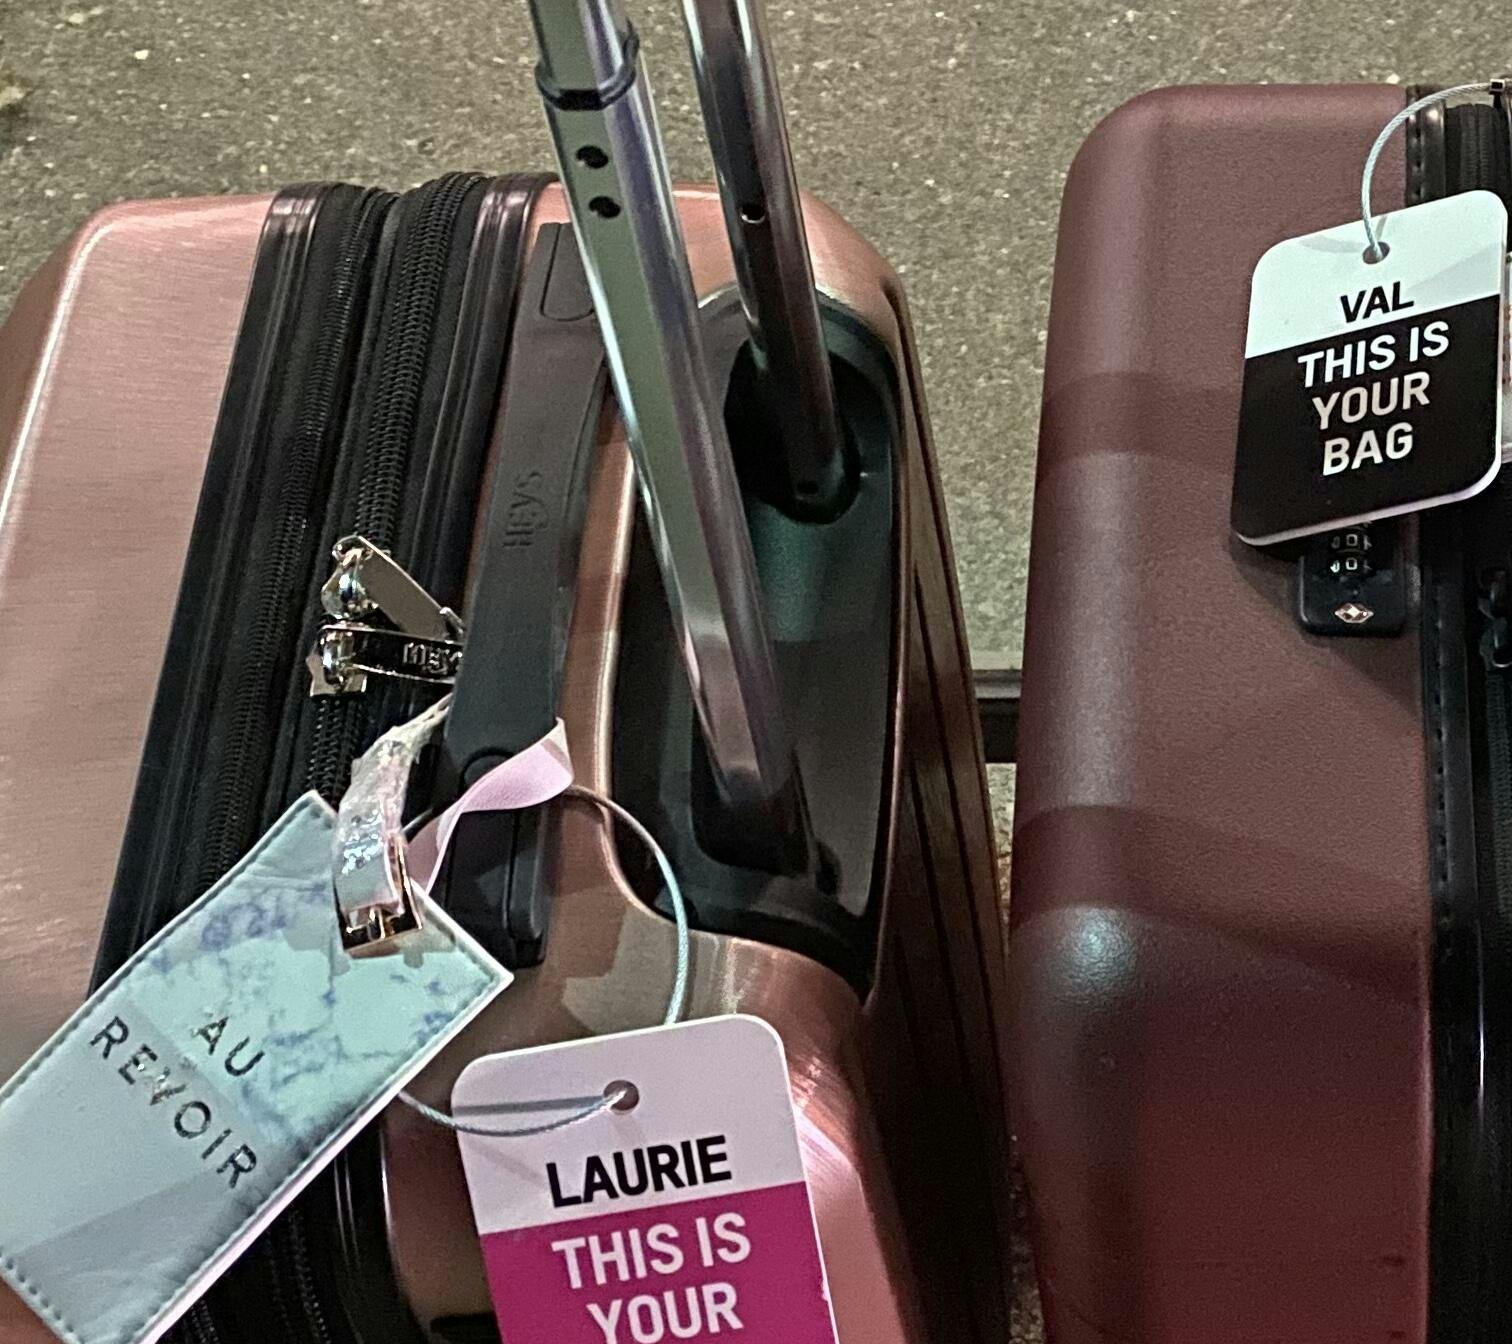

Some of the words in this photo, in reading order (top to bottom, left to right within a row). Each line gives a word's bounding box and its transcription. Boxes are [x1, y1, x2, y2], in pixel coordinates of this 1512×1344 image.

[1340, 281, 1415, 323] VAL
[1298, 334, 1396, 388] THIS
[1409, 321, 1450, 362] IS
[1312, 371, 1431, 430] YOUR
[1322, 422, 1414, 476] BAG
[192, 1016, 265, 1077] AU
[89, 1016, 258, 1188] REVOIR
[546, 1135, 732, 1208] LAURIE
[551, 1223, 684, 1289] THIS
[696, 1212, 751, 1267] IS
